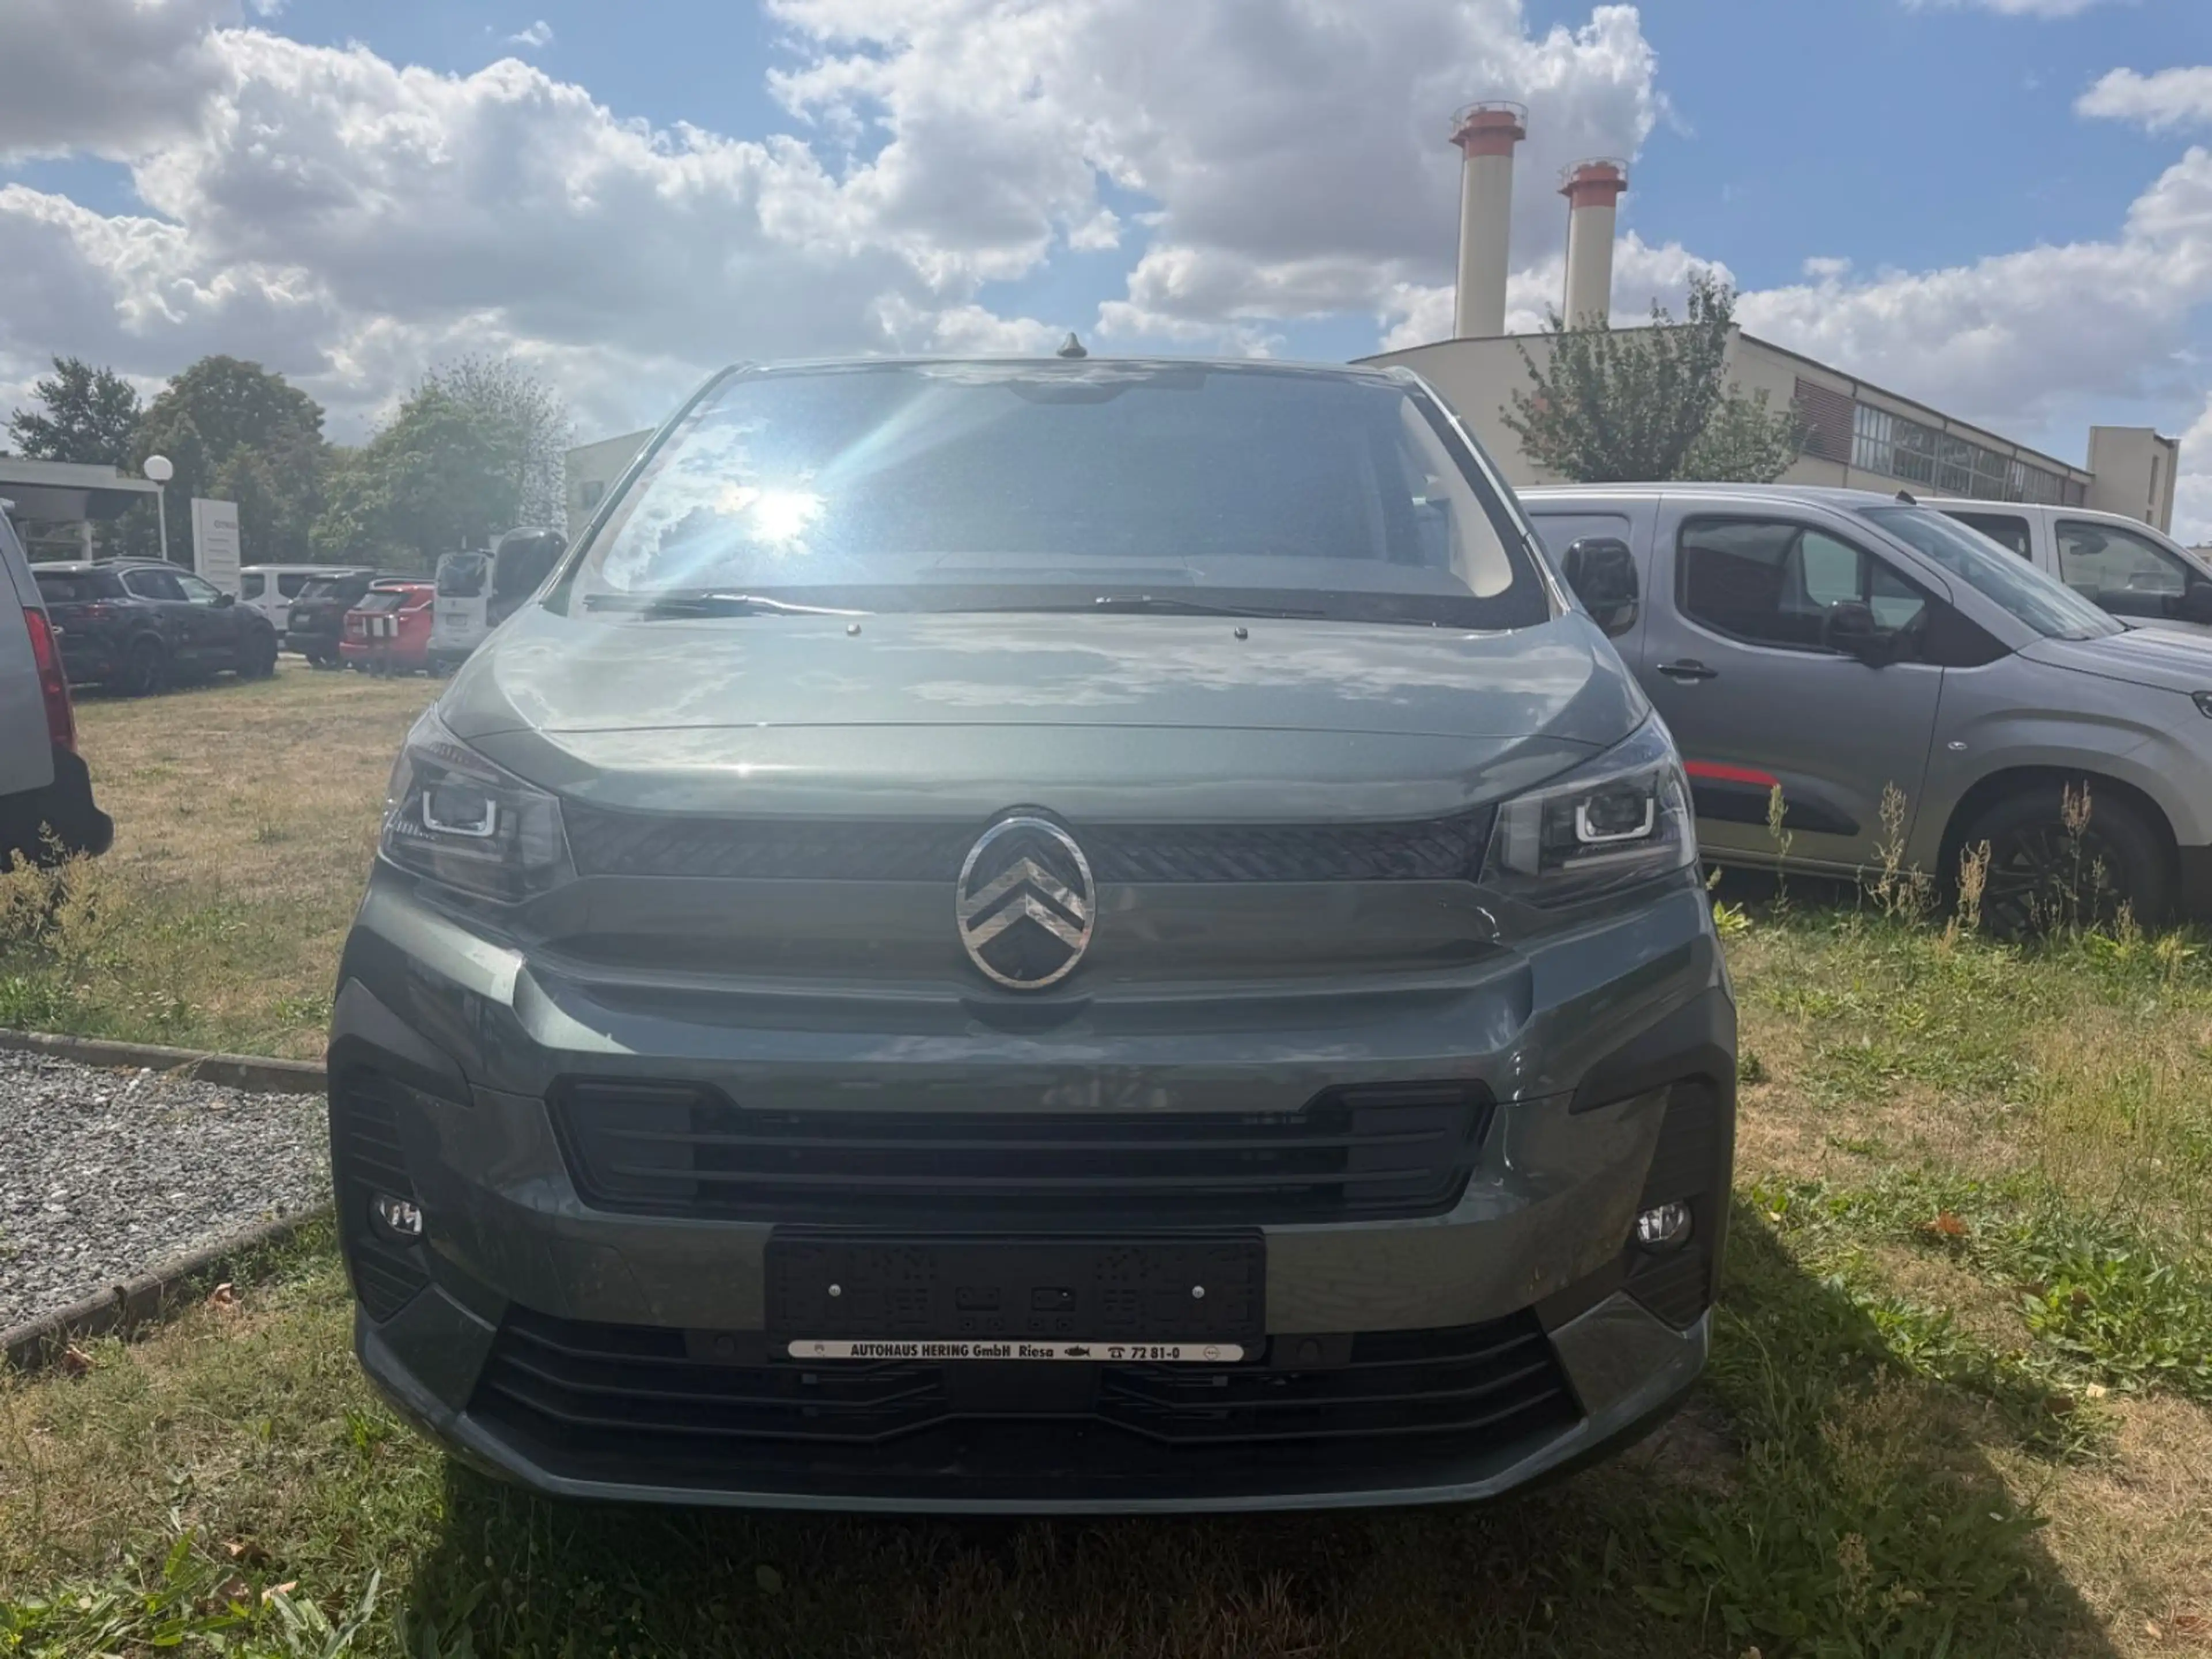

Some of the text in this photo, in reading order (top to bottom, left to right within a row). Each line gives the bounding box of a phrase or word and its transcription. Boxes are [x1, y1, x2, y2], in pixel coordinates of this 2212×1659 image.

[850, 1343, 1180, 1359] AUTOHAUS HERING GmbH Riesa 72 81-0
